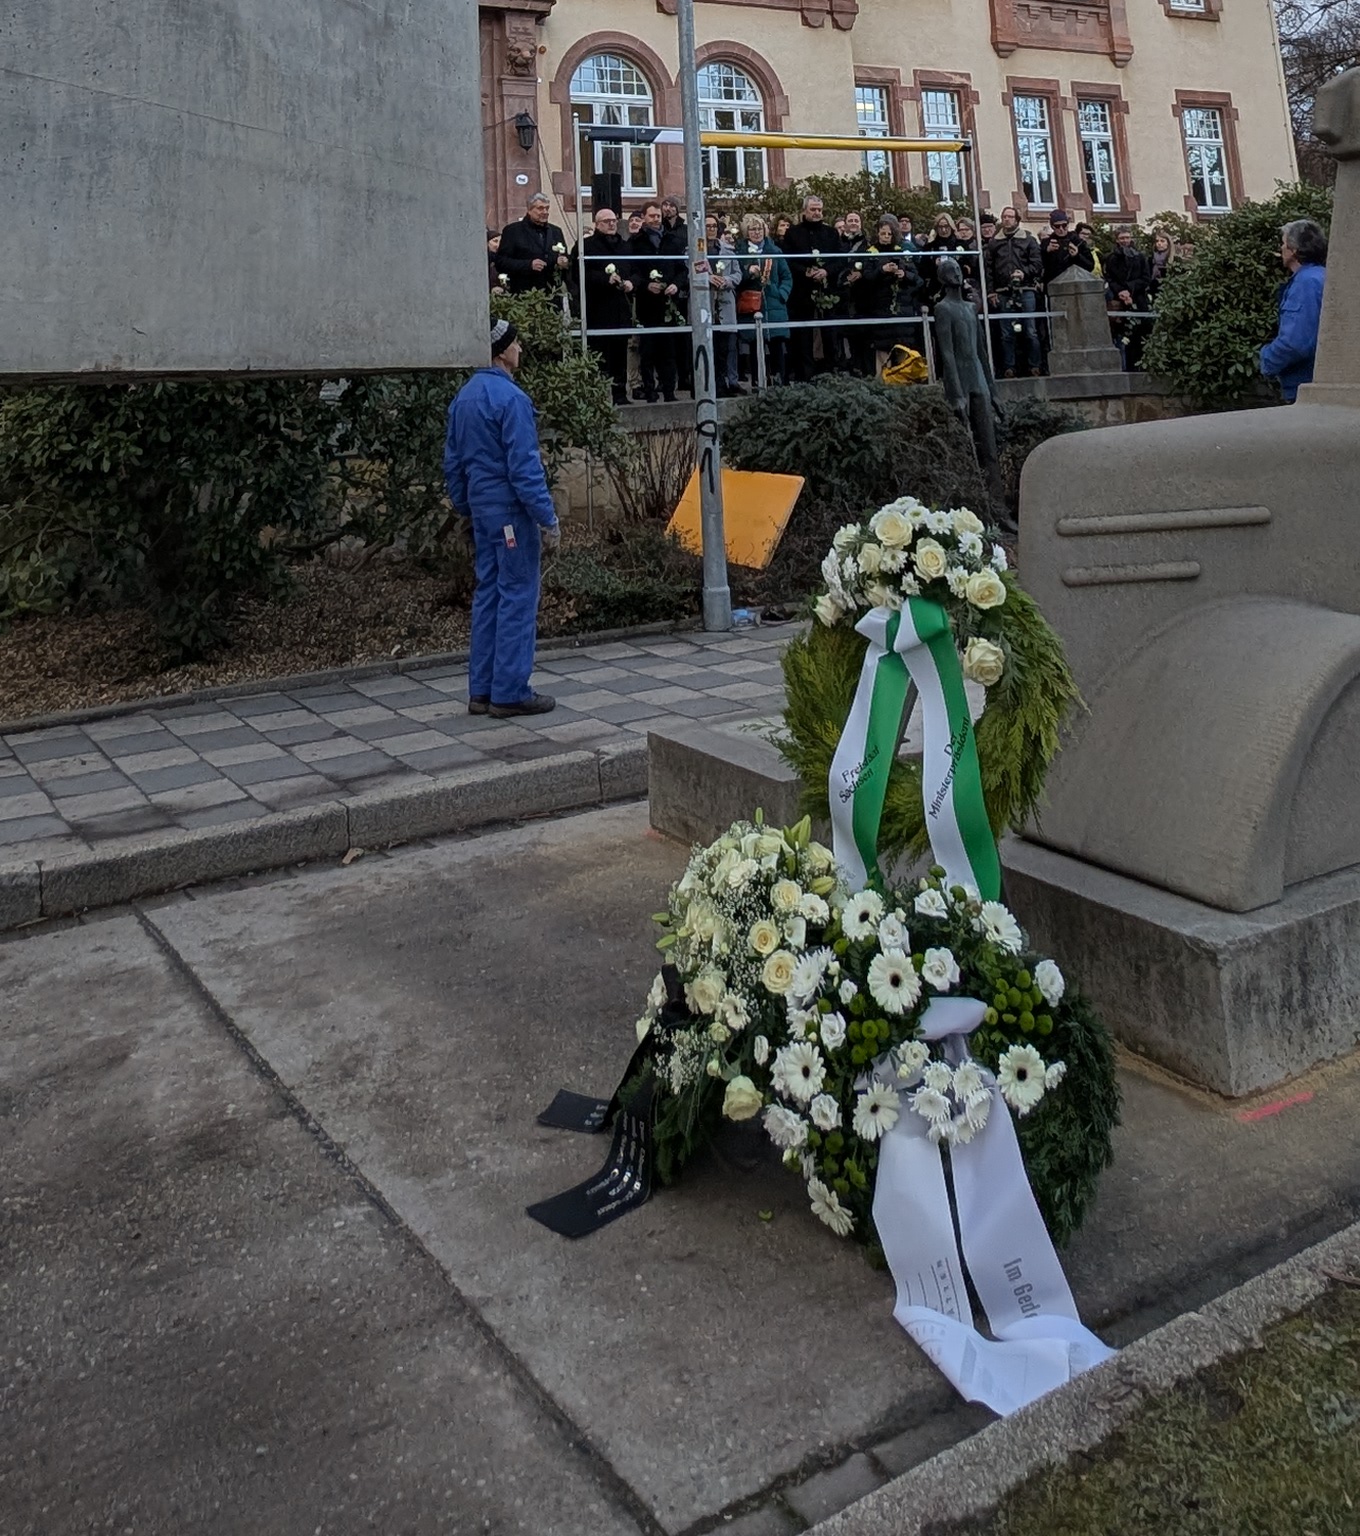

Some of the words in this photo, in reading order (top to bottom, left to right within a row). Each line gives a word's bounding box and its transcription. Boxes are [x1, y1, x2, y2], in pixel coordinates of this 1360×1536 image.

[943, 731, 957, 757] Der
[839, 768, 874, 804] Sachsen
[1003, 1258, 1023, 1282] Im
